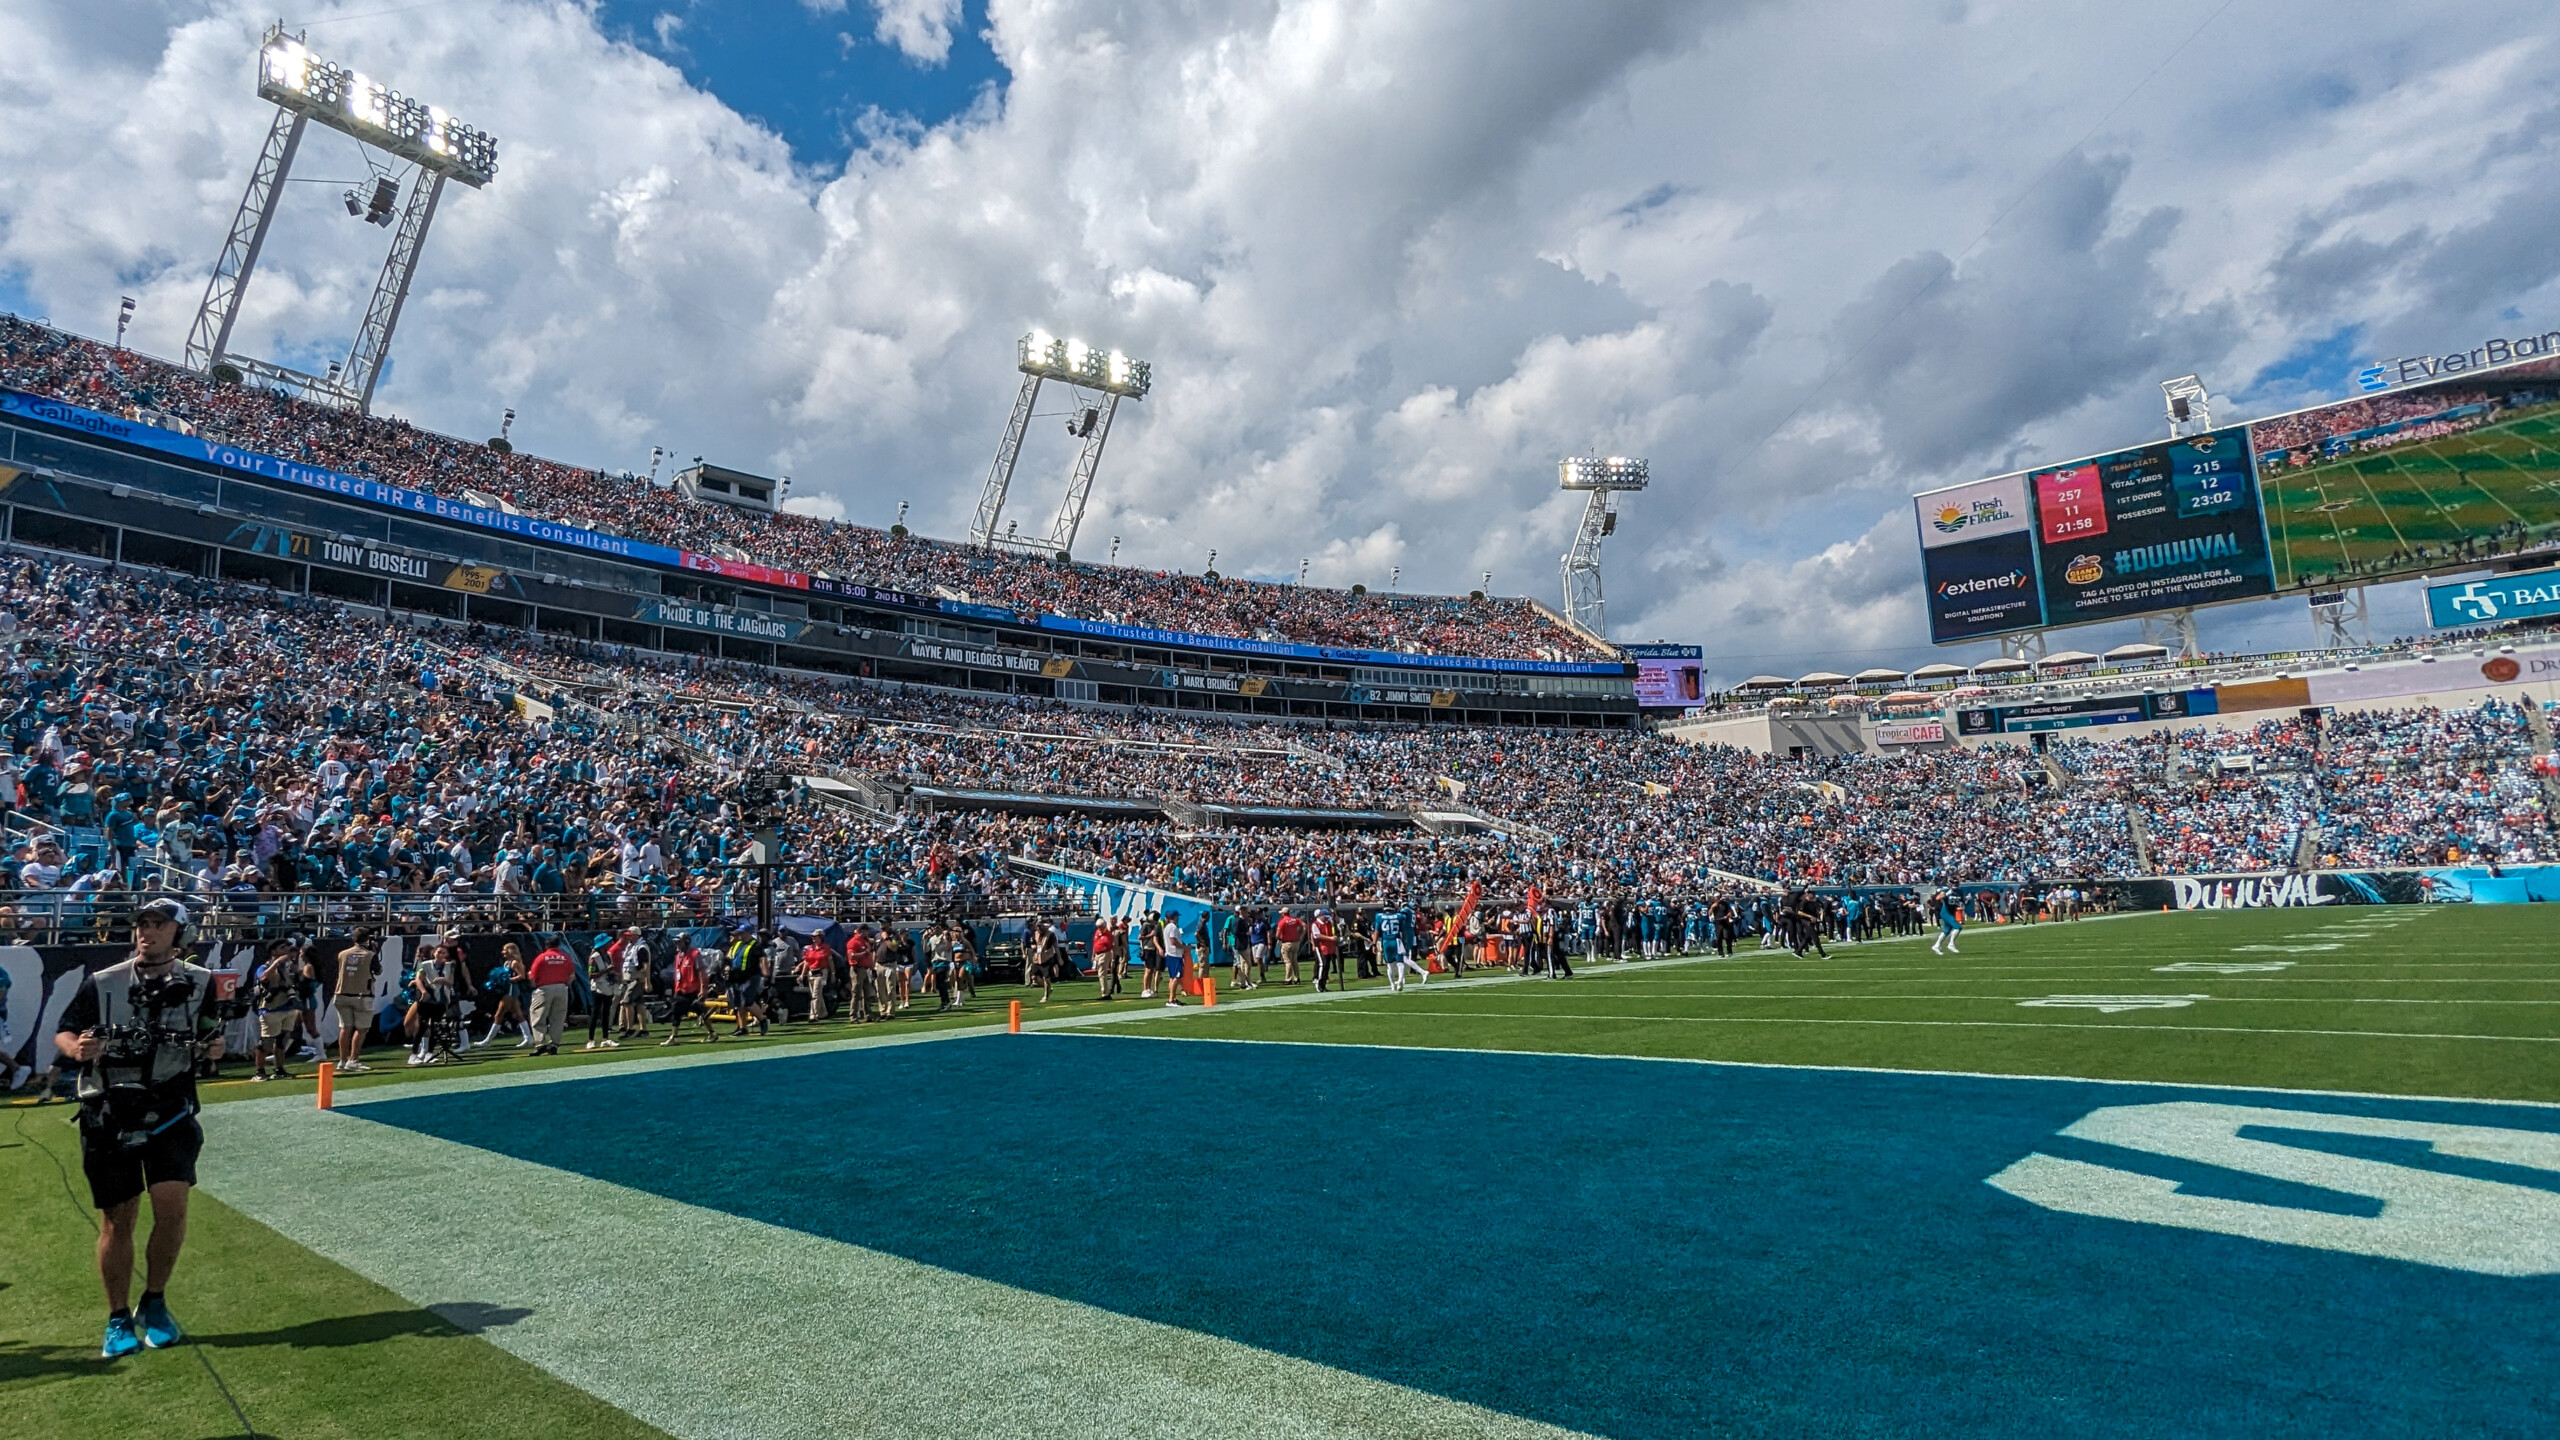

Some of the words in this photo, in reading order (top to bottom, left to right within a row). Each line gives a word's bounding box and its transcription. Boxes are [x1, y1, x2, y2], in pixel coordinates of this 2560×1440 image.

[29, 400, 132, 437] Gallagher
[2193, 461, 2220, 475] 215
[2111, 480, 2135, 489] TOTAL
[2136, 474, 2163, 484] YARDS
[2201, 478, 2218, 489] 12
[205, 443, 264, 471] Your
[276, 460, 366, 497] Trusted
[376, 485, 404, 505] HR
[414, 495, 426, 510] &
[436, 499, 520, 531] Benefits
[529, 522, 629, 554] Consultant
[2058, 489, 2081, 502] 257
[2117, 496, 2131, 504] 1ST
[2132, 491, 2162, 501] DOWNS
[2191, 491, 2232, 507] 23:02
[1972, 497, 2003, 512] Fresh
[2065, 505, 2079, 516] 11
[2117, 506, 2166, 520] POSSESSION
[2056, 518, 2092, 533] 21:58
[291, 535, 311, 556] 71
[322, 541, 363, 566] TONY
[369, 551, 428, 579] BOSELLI
[2114, 532, 2242, 575] #DUUUVAL
[783, 572, 798, 586] 14
[2069, 568, 2097, 577] GIANT
[464, 578, 485, 589] 2001
[1947, 572, 2017, 596] extenet
[2081, 590, 2097, 599] TAG
[2099, 588, 2105, 596] A
[2106, 584, 2135, 595] PHOTO
[2137, 582, 2149, 590] ON
[2151, 573, 2201, 588] INSTAGRAM
[2204, 570, 2222, 580] FOR
[814, 579, 833, 592] 4TH
[840, 583, 867, 597] 15:00
[874, 590, 890, 602] 2ND
[891, 593, 898, 602] &
[900, 594, 905, 603] 5
[2075, 597, 2109, 608] CHANCE
[2110, 593, 2121, 602] TO
[2123, 591, 2139, 600] SEE
[2141, 590, 2149, 598] IT
[2151, 587, 2164, 596] ON
[2166, 584, 2183, 594] THE
[2185, 575, 2242, 590] VIDEOBOARD
[952, 604, 958, 612] 6
[1945, 609, 1970, 619] DIGITAL
[1971, 601, 2026, 615] INFRASTRUCTURE
[658, 605, 693, 624] PRIDE
[697, 610, 710, 626] OF
[714, 613, 734, 630] THE
[737, 617, 786, 639] JAGUARS
[1968, 612, 2003, 622] SOLUTIONS
[1079, 621, 1106, 633] Your
[1111, 626, 1154, 640] Trusted
[1159, 632, 1173, 642] HR
[1178, 634, 1184, 643] &
[1189, 635, 1233, 649] Benefits
[1238, 640, 1295, 655] Consultant
[911, 643, 942, 660] WAYNE
[944, 647, 962, 662] AND
[965, 650, 1003, 667] DELORES
[1006, 655, 1039, 672] WEAVER
[1336, 650, 1371, 661] Gallagher
[1661, 648, 1679, 656] Blue
[1396, 655, 1419, 664] Your
[1423, 656, 1461, 667] Trusted
[1465, 659, 1477, 667] HR
[1492, 660, 1534, 671] Benefits
[1537, 663, 1593, 672] Consultant
[2530, 658, 2560, 673] DR
[1172, 675, 1179, 686] 8
[1184, 675, 1205, 688] MARK
[1206, 677, 1239, 692] BRUNELL
[2036, 674, 2058, 682] FARAH
[1370, 690, 1381, 701] 82
[1385, 691, 1408, 701] JIMMY
[1410, 692, 1431, 703] SMITH
[2024, 706, 2051, 715] D'ANDRE
[2052, 705, 2073, 713] SWIFT
[124, 719, 132, 729] 8
[1878, 727, 1911, 740] tropical
[1912, 726, 1942, 740] CAFE
[329, 766, 339, 776] 15
[1381, 919, 1400, 935] 46
[223, 979, 235, 992] G
